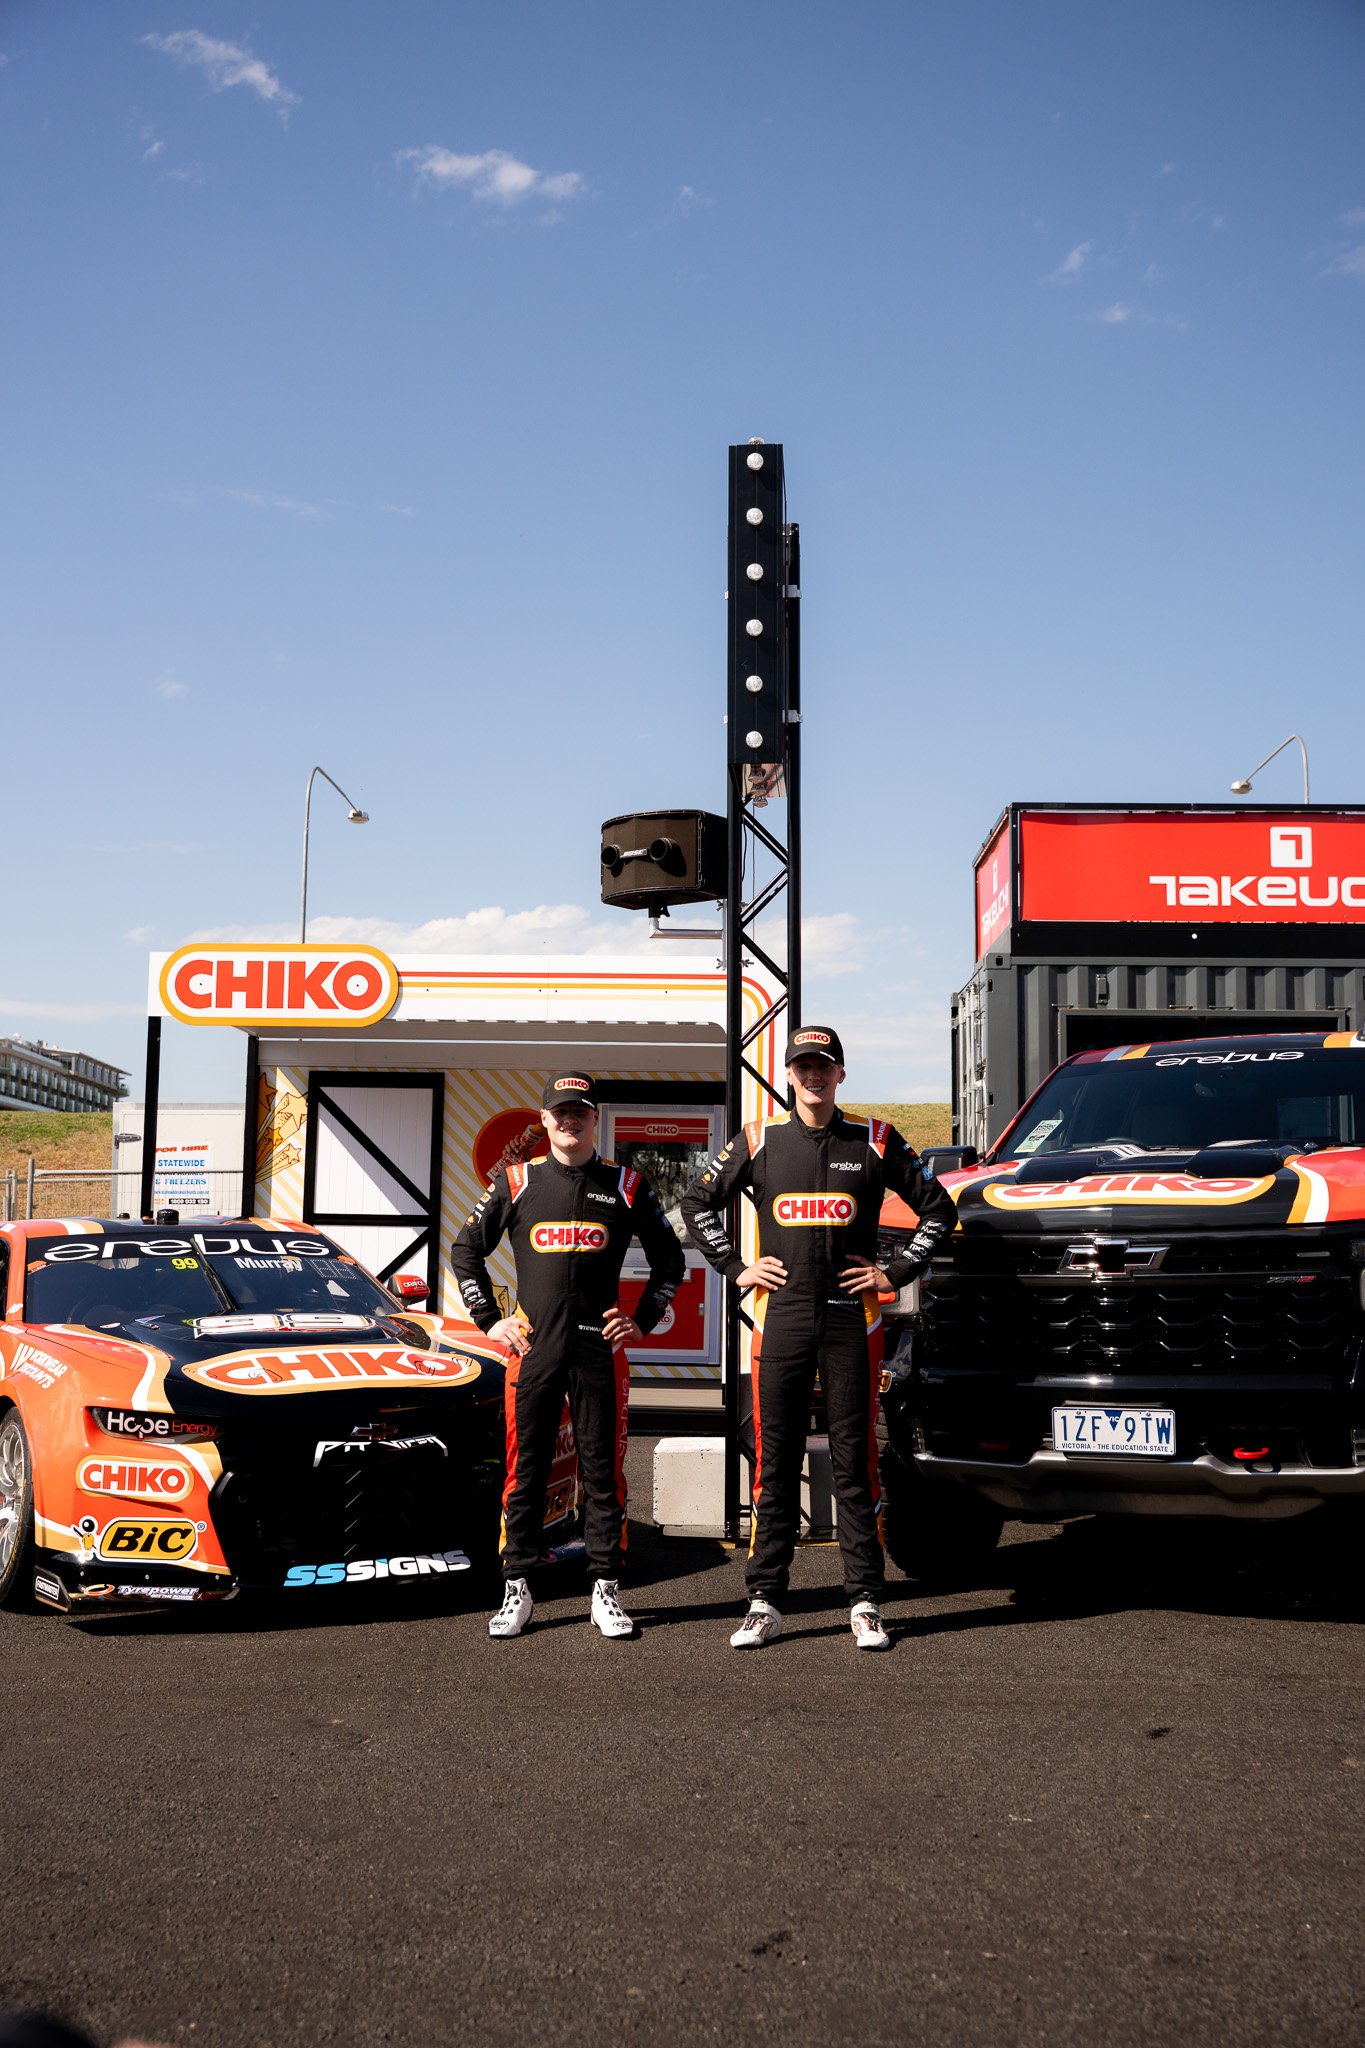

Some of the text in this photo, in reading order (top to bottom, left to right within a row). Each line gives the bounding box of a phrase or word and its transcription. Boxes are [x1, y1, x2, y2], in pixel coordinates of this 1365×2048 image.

[174, 959, 383, 1011] CHIKO
[795, 1033, 829, 1043] CHIKO
[1155, 1050, 1305, 1067] erebus
[556, 1079, 588, 1090] CHIKO
[646, 1124, 678, 1135] CHIKO
[181, 1144, 209, 1152] HIRE
[157, 1159, 206, 1167] STATEWIDE
[830, 1161, 862, 1169] erebus
[1003, 1176, 1255, 1198] CHIKO
[777, 1199, 852, 1220] CHIKO
[535, 1225, 605, 1247] CHIKO
[44, 1234, 330, 1262] erebus
[171, 1257, 199, 1270] 99
[233, 1256, 303, 1271] Murray
[205, 1350, 463, 1386] CHIKO
[106, 1410, 218, 1439] Hope Energy
[1060, 1415, 1171, 1445] 1ZF 9TW
[1061, 1442, 1092, 1450] VICTORIA
[1111, 1443, 1149, 1452] EDUCATION
[1149, 1445, 1168, 1453] STATE
[83, 1463, 186, 1495] CHIKO
[118, 1585, 200, 1597] Tyrepower
